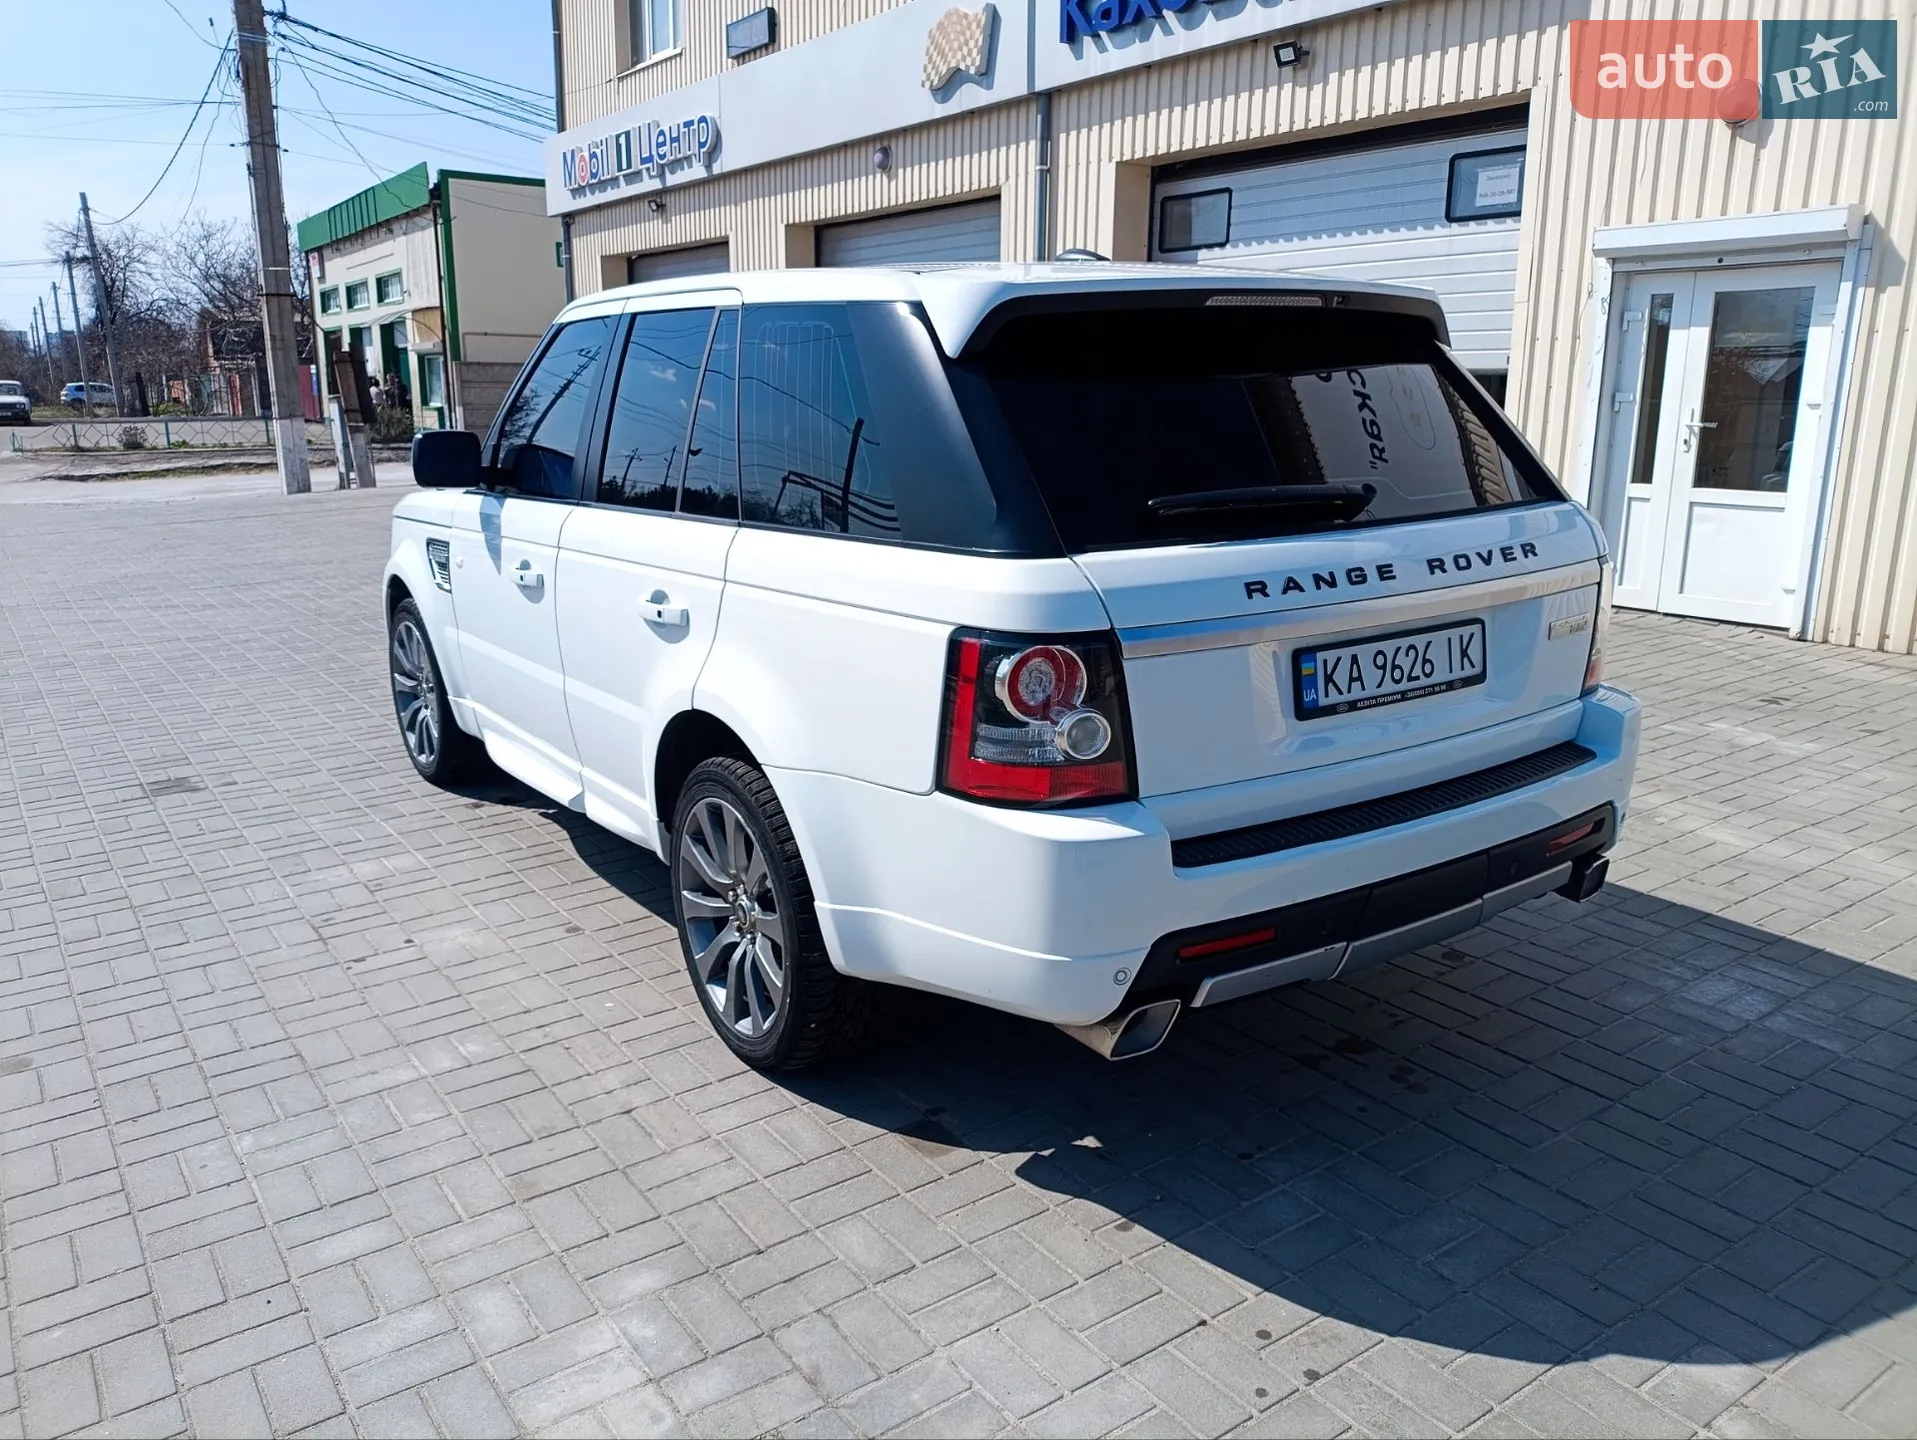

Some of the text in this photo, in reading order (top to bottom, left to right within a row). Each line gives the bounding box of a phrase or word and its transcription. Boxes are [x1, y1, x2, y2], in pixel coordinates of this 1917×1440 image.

[562, 114, 711, 189] Mobil 1 Центр
[1243, 541, 1539, 600] RANGE ROVER
[1303, 689, 1317, 702] UA
[1322, 653, 1366, 698] KA
[1372, 640, 1435, 689] 9626
